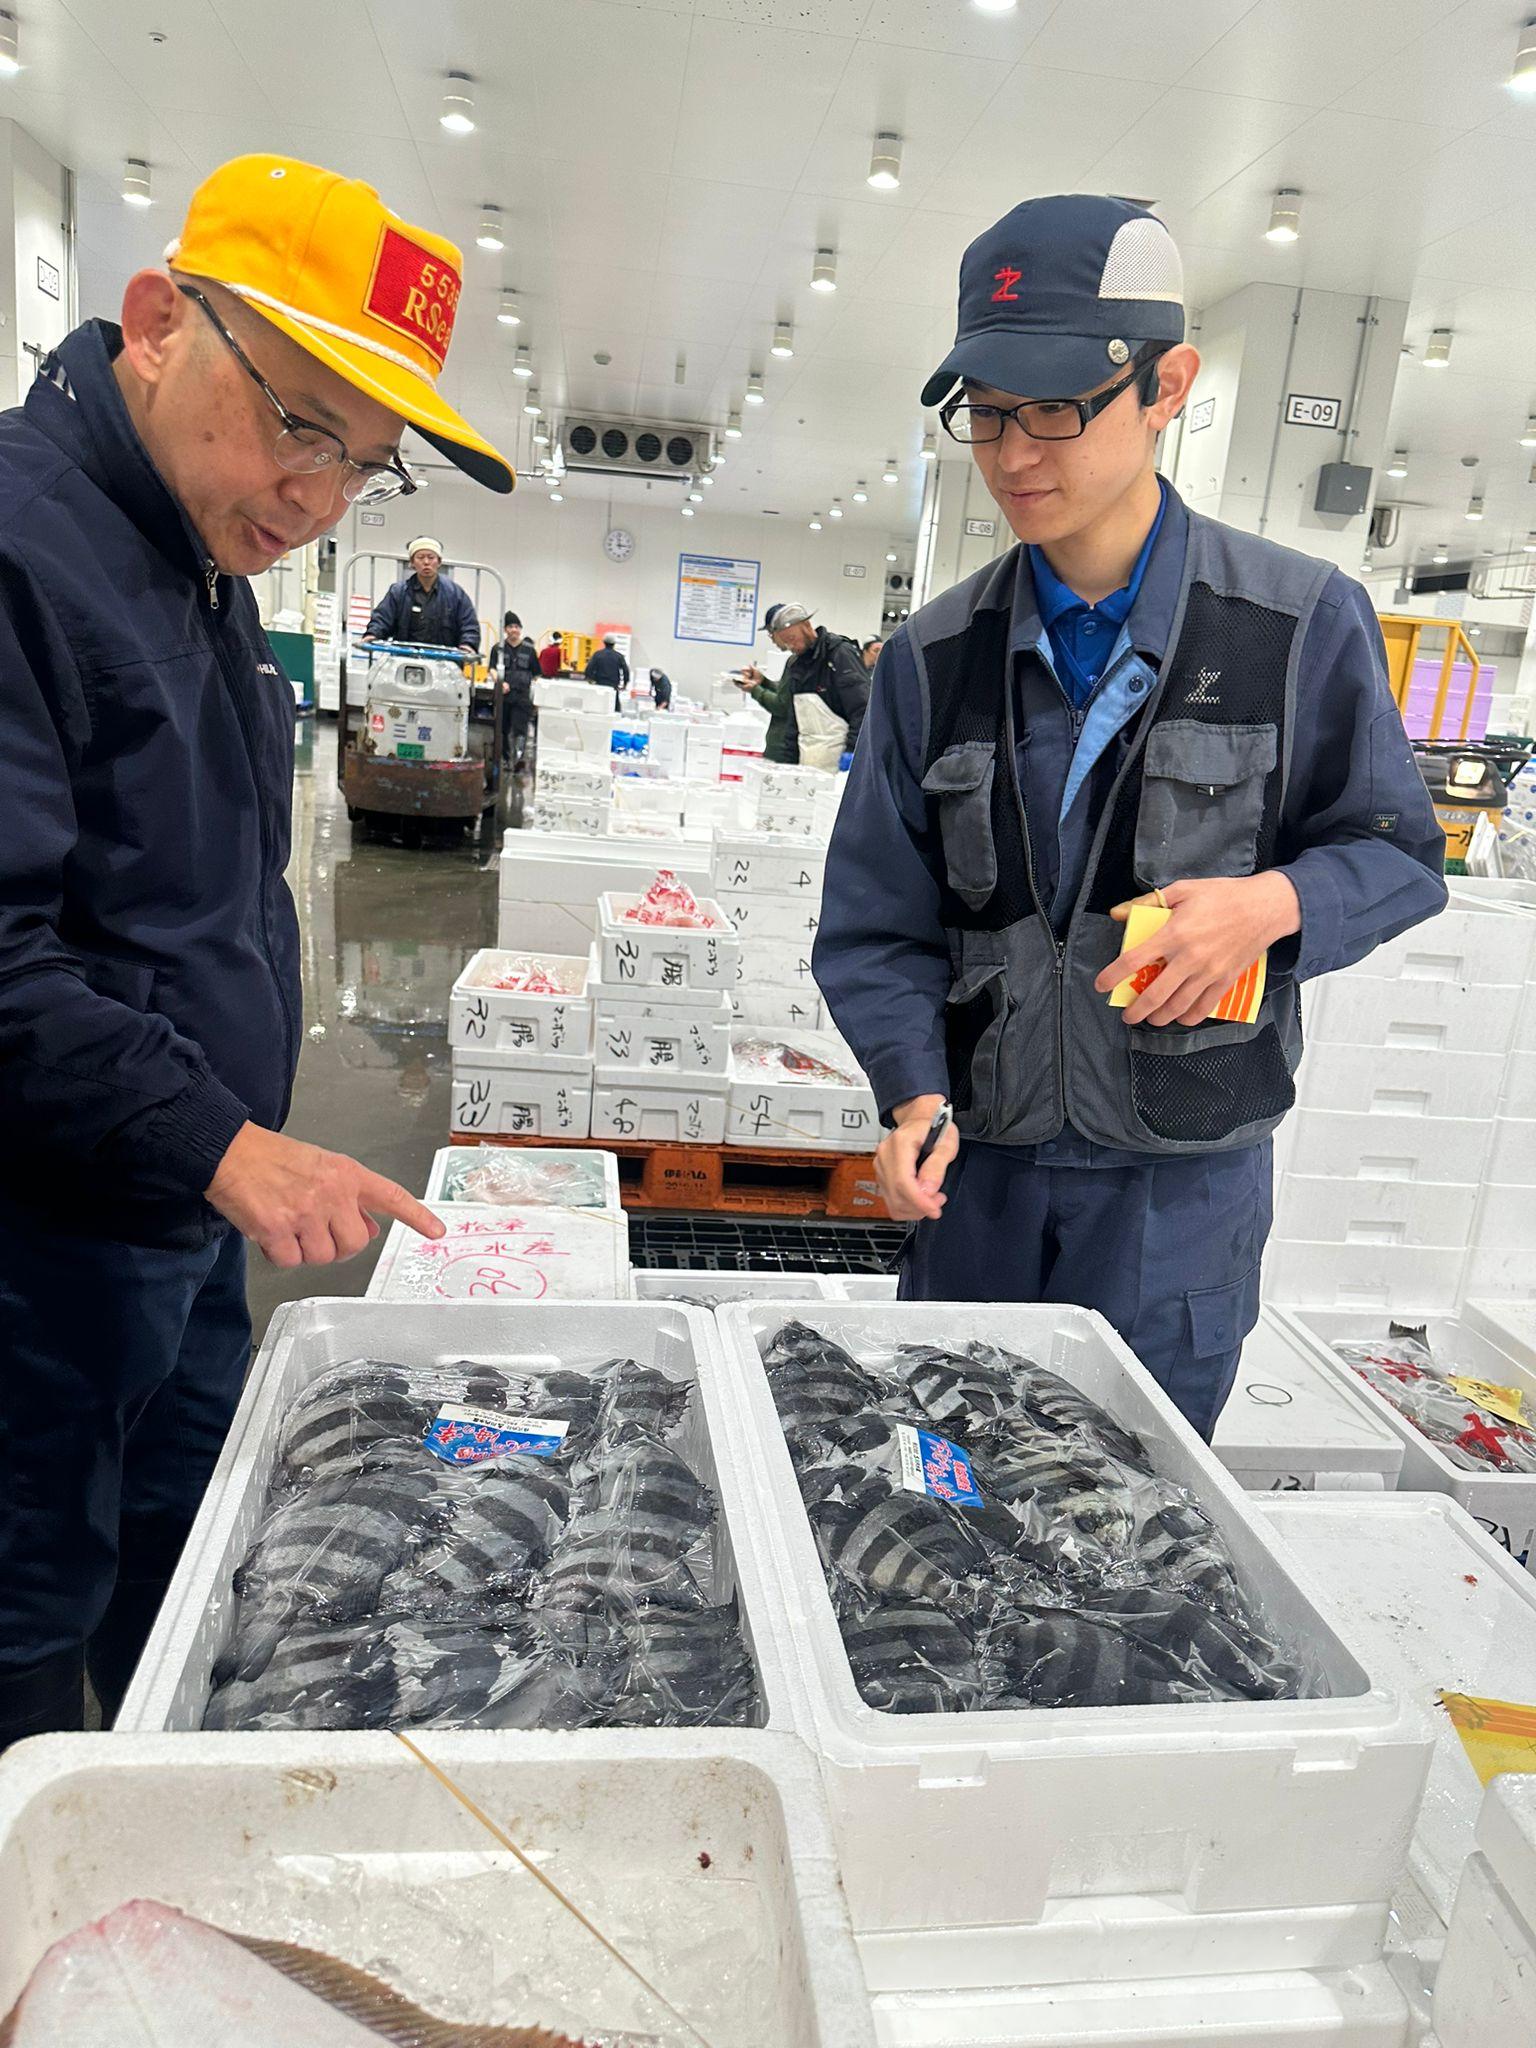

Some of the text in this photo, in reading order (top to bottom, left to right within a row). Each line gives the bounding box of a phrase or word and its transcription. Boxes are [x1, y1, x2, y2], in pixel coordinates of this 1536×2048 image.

[1293, 401, 1333, 422] E-09
[788, 870, 812, 888] 4
[803, 917, 818, 932] 4
[793, 958, 811, 979] 4
[787, 1004, 806, 1022] 4
